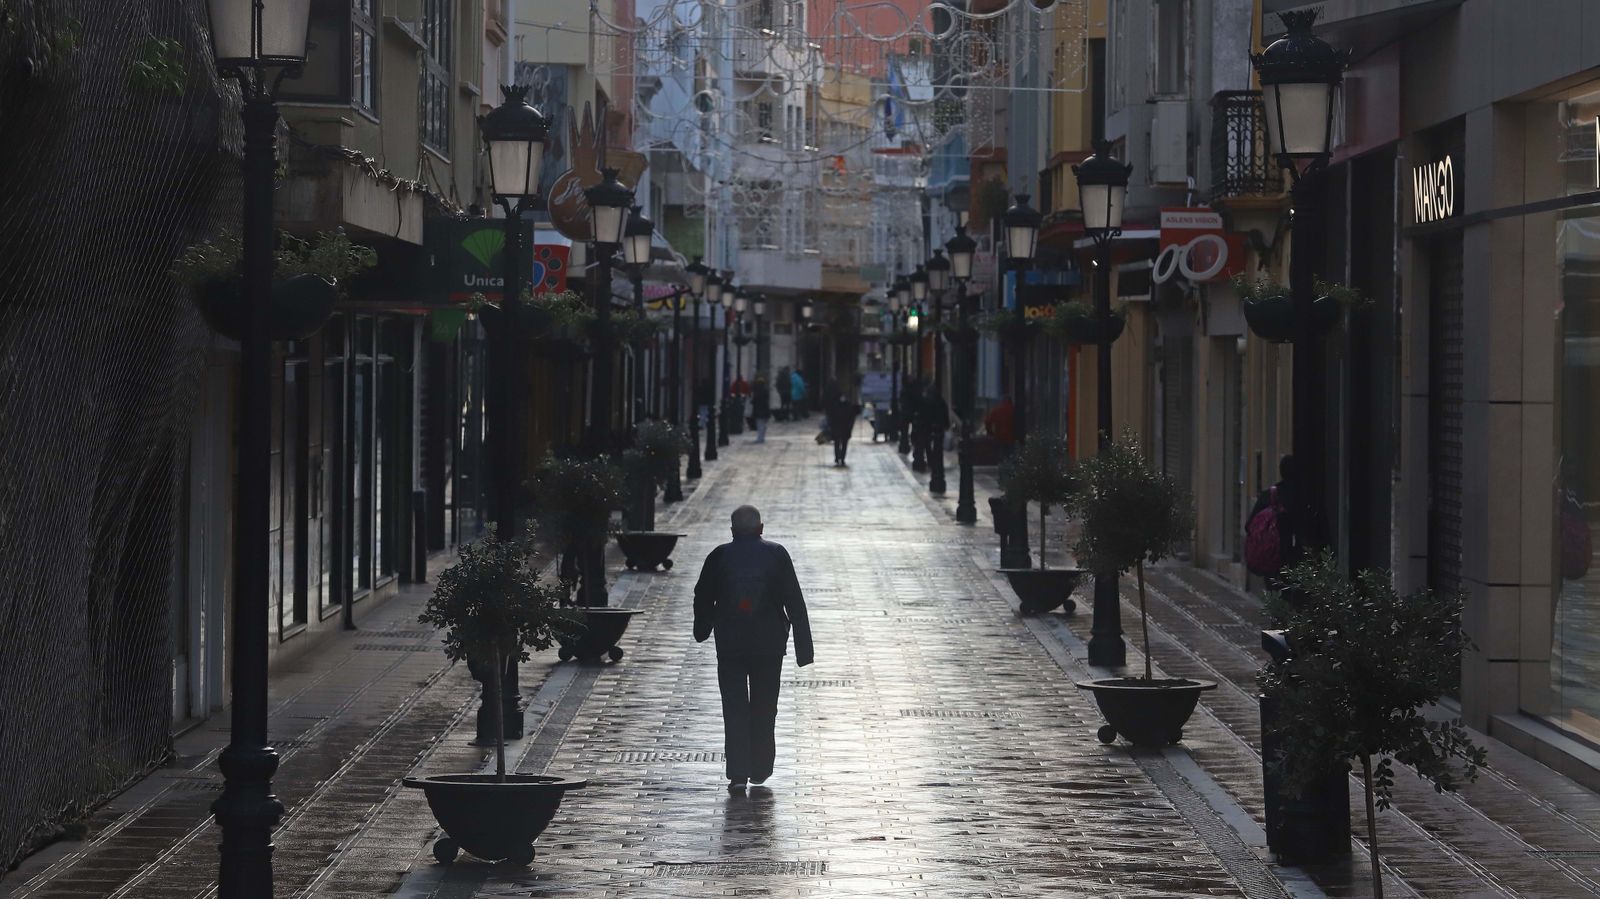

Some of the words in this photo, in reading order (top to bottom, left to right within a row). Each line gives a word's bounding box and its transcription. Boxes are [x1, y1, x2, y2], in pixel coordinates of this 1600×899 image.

[1413, 155, 1454, 224] MANGO
[1166, 216, 1193, 224] ASLENS
[1195, 217, 1219, 225] VISION
[463, 274, 505, 287] Unica
